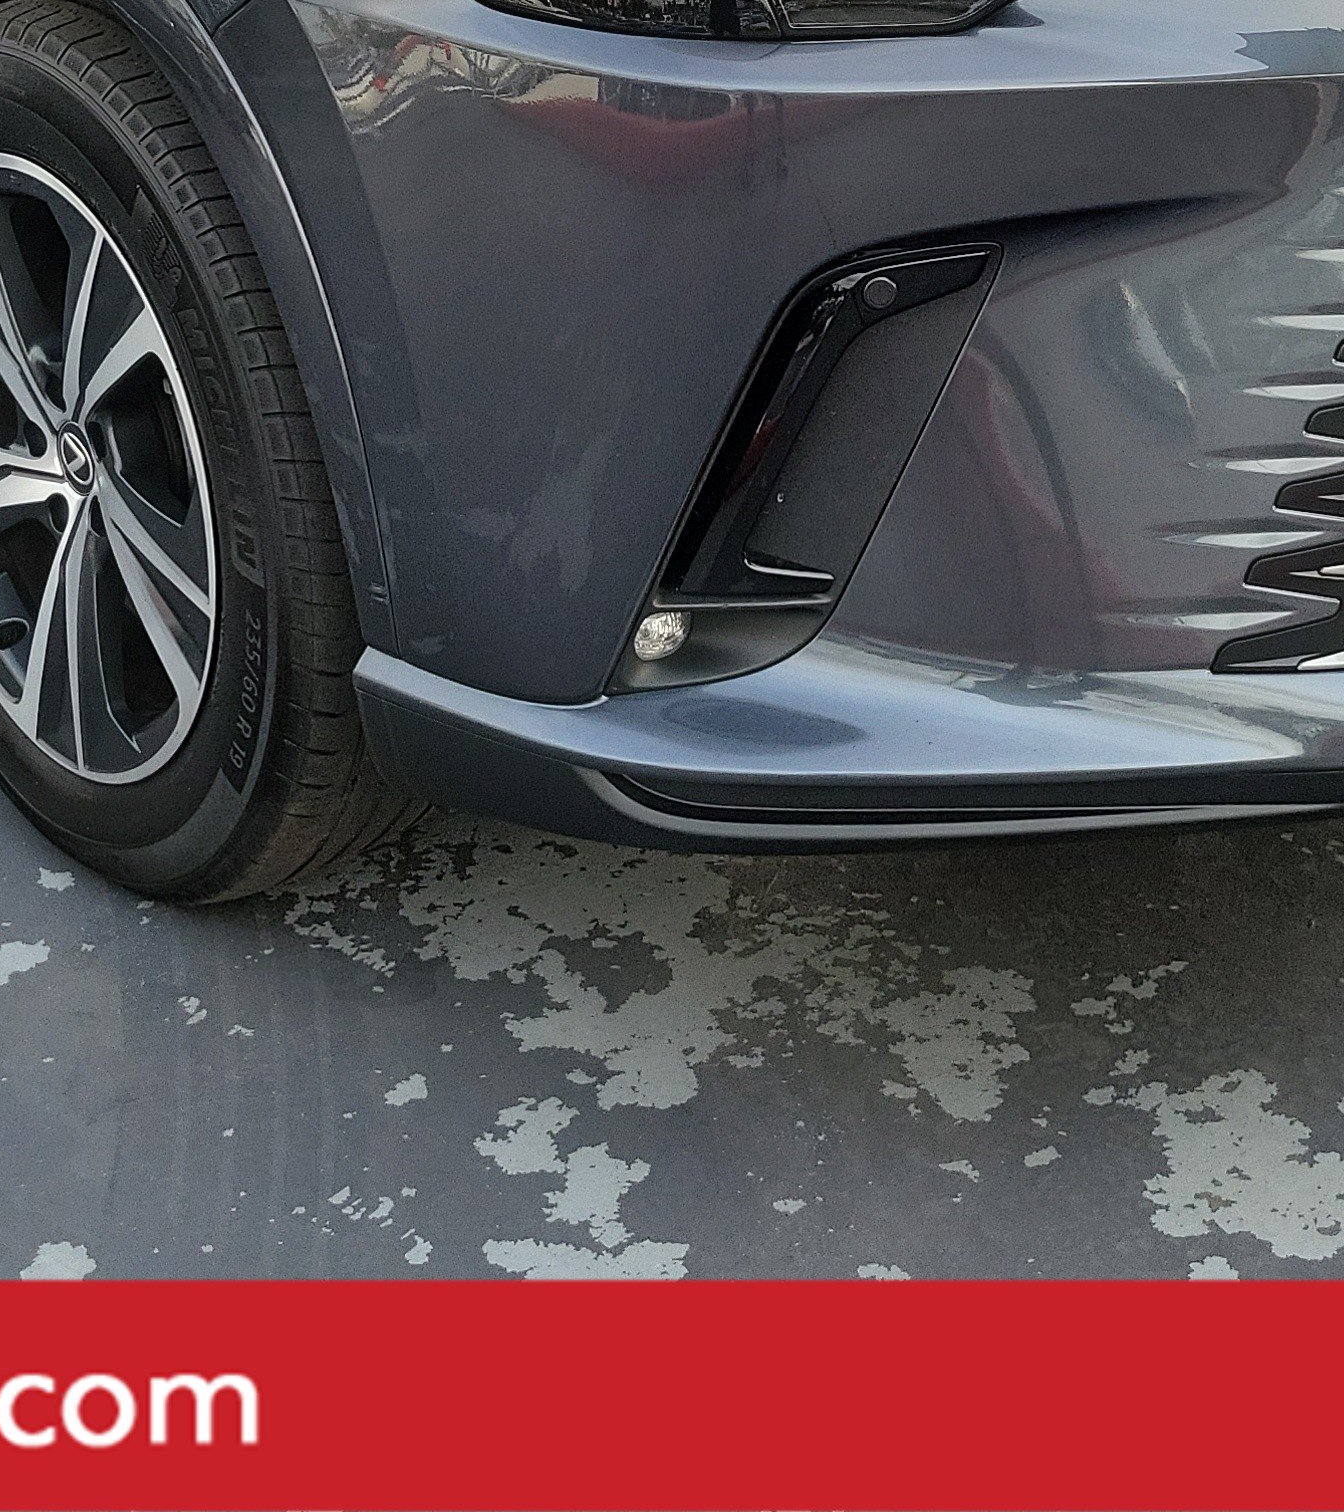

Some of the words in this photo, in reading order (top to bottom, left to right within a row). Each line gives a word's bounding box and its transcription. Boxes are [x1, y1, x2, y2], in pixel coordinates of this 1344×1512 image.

[241, 608, 262, 714] 235/60
[236, 713, 252, 739] R
[229, 740, 247, 770] 19
